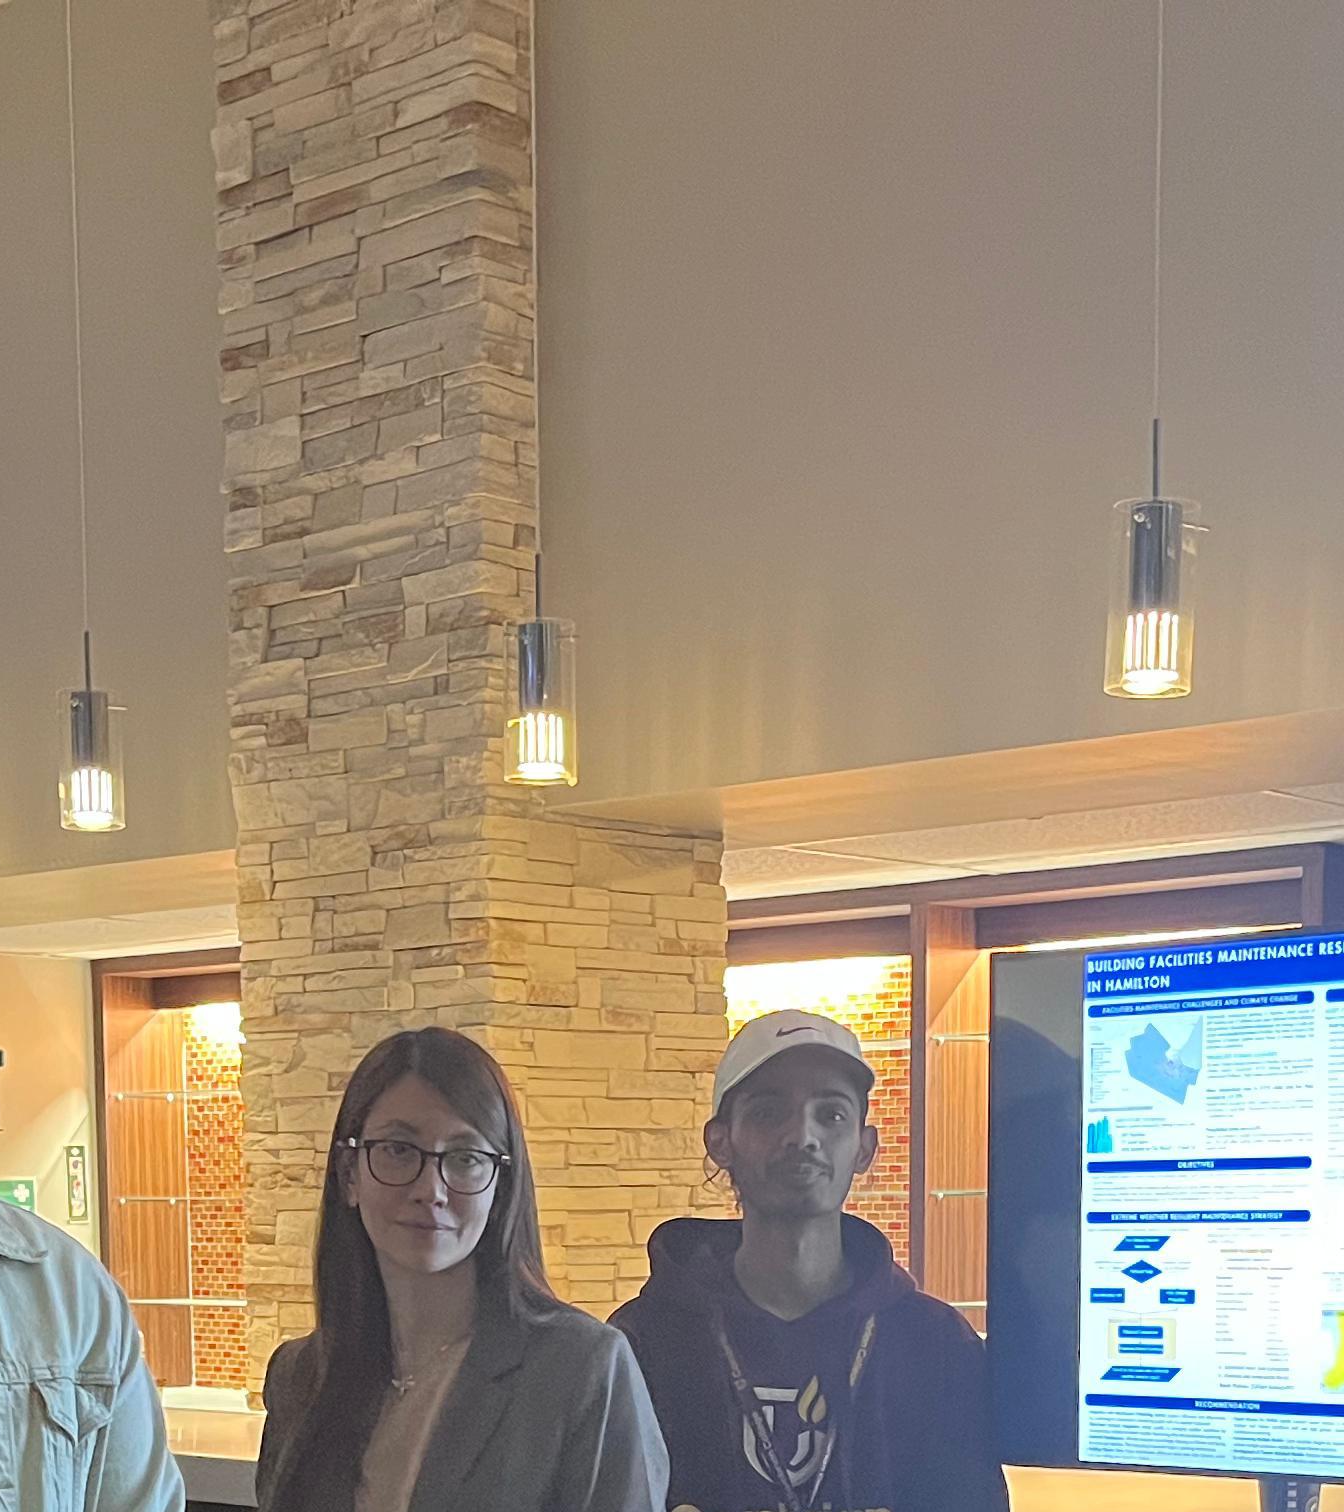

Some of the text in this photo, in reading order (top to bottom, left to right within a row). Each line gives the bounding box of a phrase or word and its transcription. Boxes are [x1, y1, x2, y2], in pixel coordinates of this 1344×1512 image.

[1087, 955, 1145, 974] BUILDING
[1148, 950, 1213, 969] FACILITIES
[1217, 943, 1313, 964] MAINTENANCE
[1087, 975, 1171, 993] IN HAMILTON
